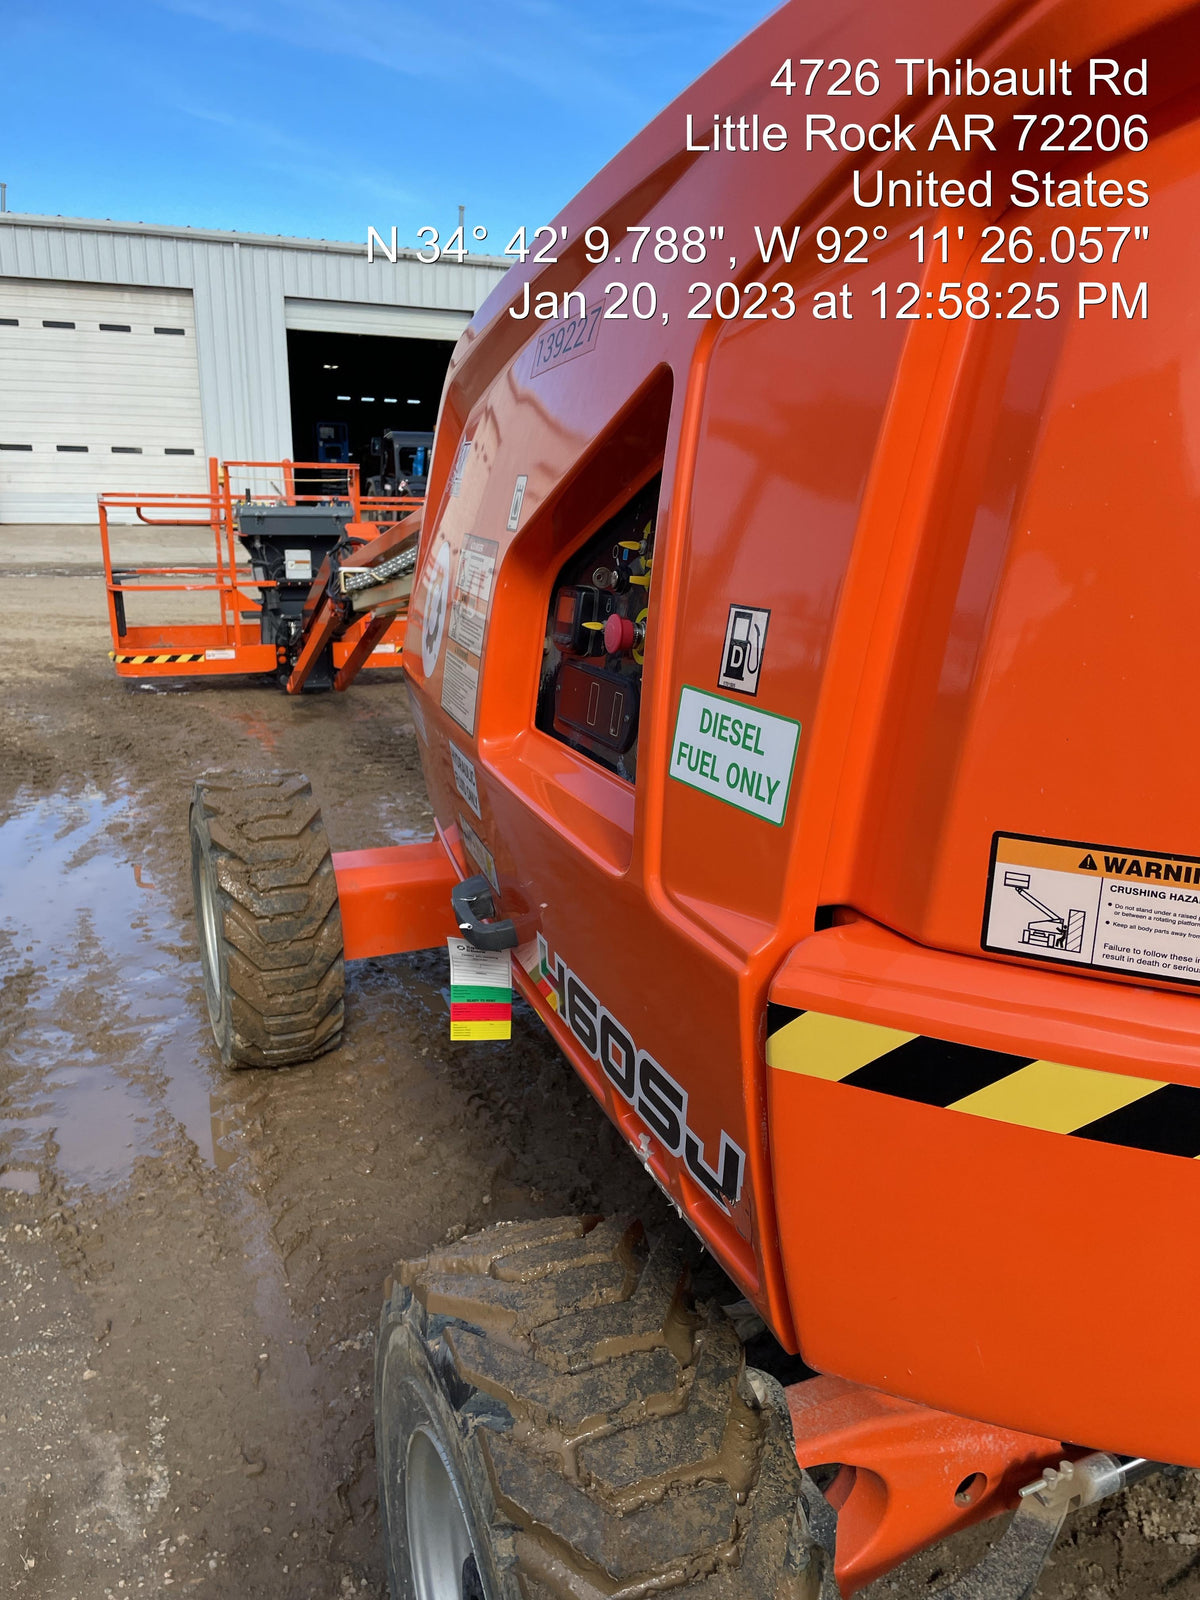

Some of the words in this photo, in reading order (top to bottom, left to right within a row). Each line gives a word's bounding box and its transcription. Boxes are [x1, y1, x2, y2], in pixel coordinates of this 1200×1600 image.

[536, 305, 603, 368] 139227
[730, 645, 744, 669] D
[698, 707, 765, 756] DIESEL
[676, 741, 720, 783] FUEL
[725, 762, 781, 806] ONLY
[1110, 884, 1167, 900] CRUSHING
[1169, 892, 1200, 904] HAZA
[1112, 921, 1128, 929] Keep
[1137, 925, 1153, 933] body
[1121, 911, 1147, 920] between
[1153, 916, 1177, 925] rotating
[1102, 953, 1125, 962] result
[1126, 956, 1135, 964] in
[1136, 958, 1160, 967] death
[1103, 942, 1131, 953] Failure
[1133, 947, 1141, 955] to
[1143, 949, 1168, 959] follow
[1169, 953, 1193, 963] these
[537, 930, 746, 1217] 460SJ
